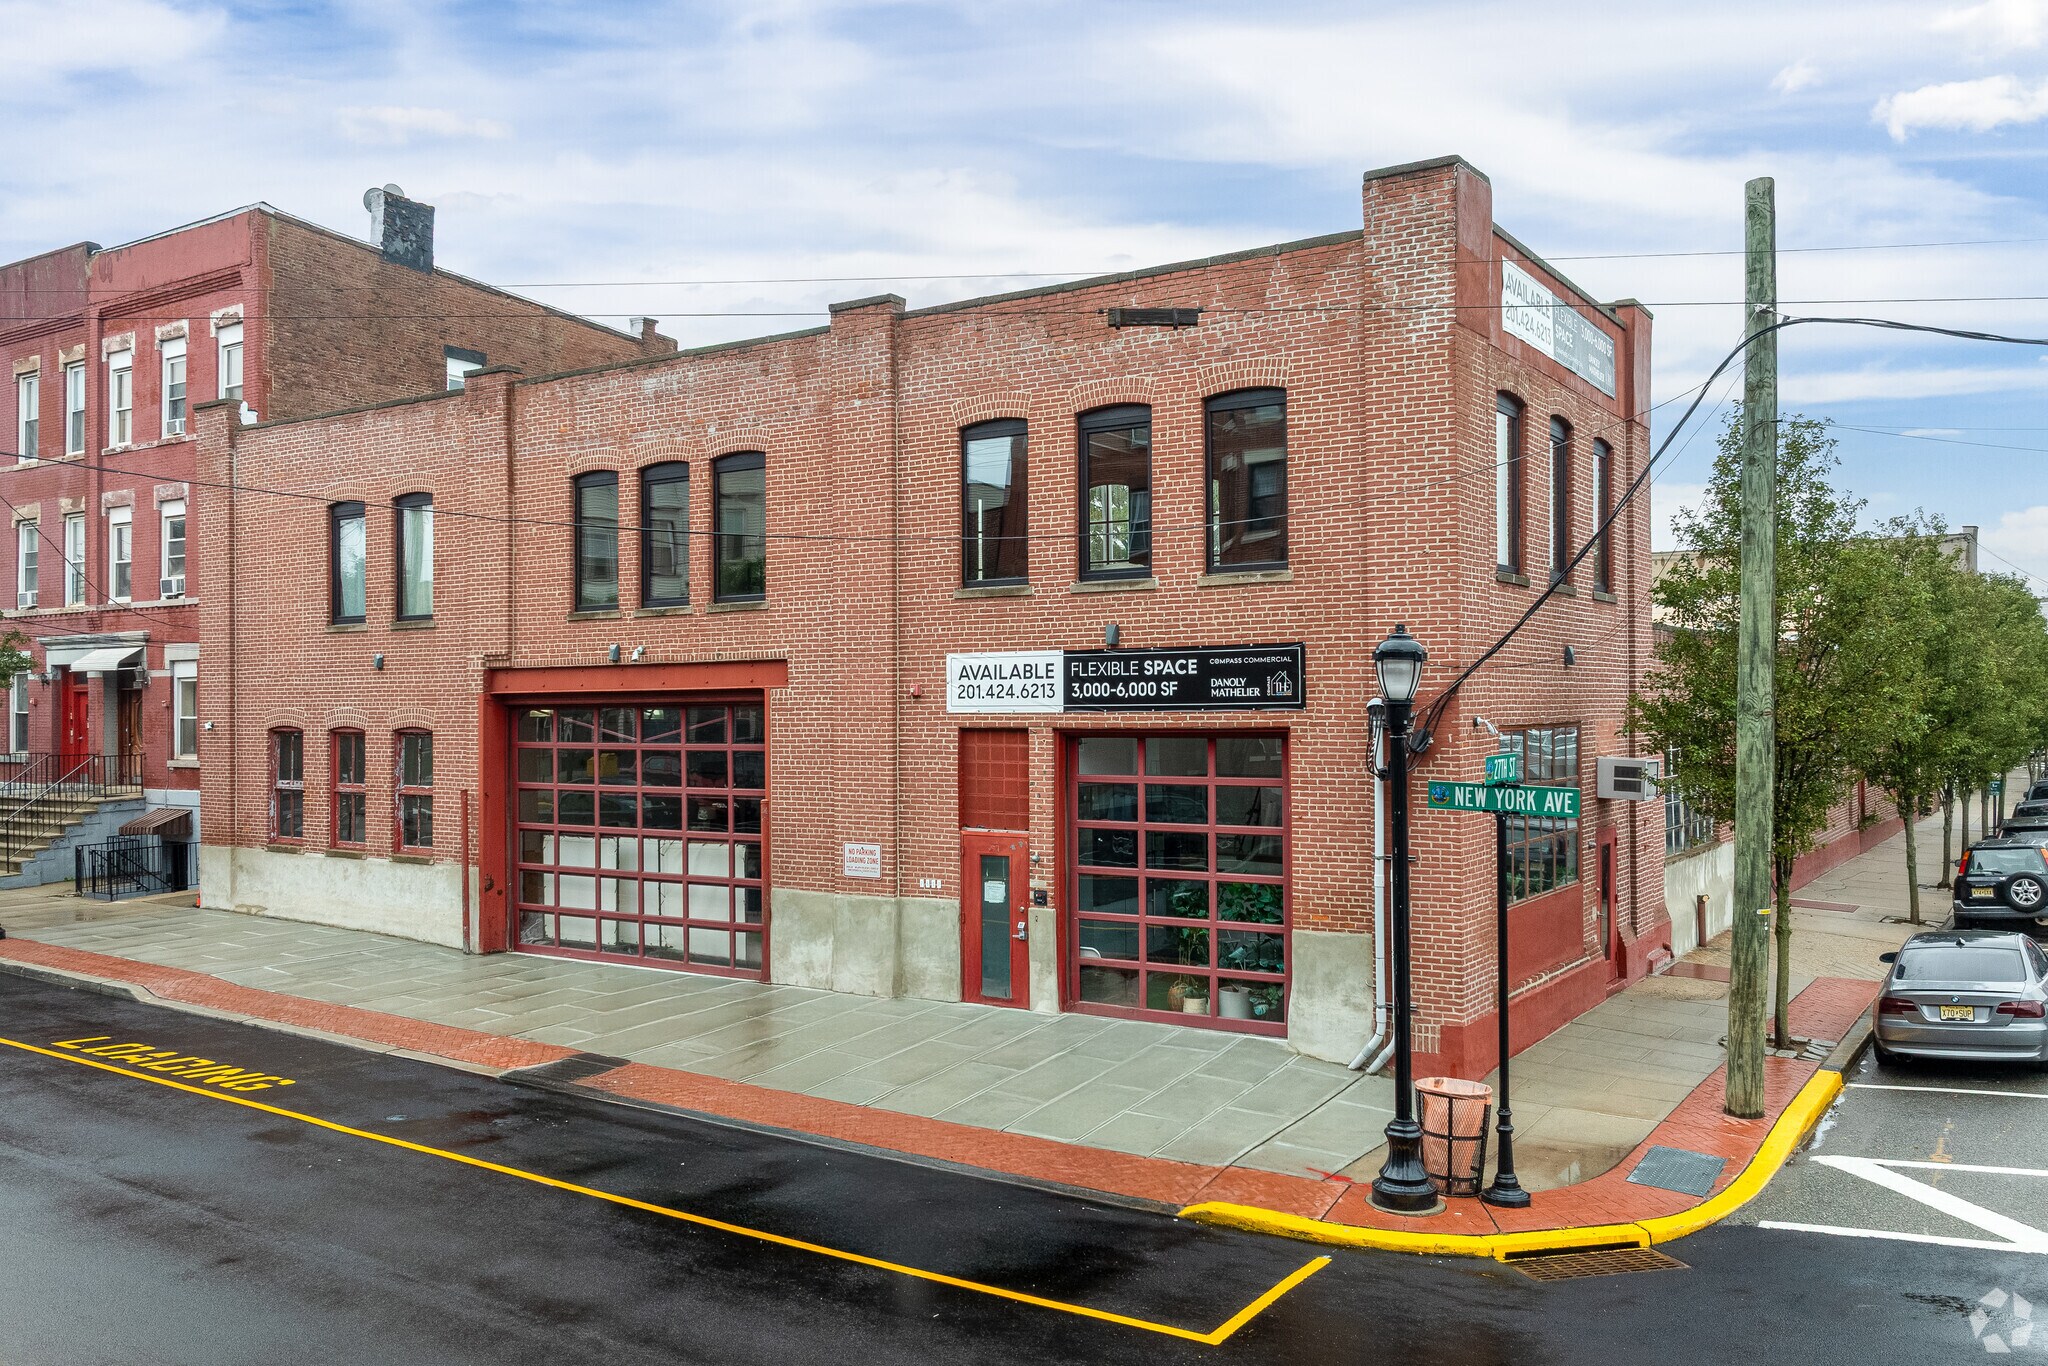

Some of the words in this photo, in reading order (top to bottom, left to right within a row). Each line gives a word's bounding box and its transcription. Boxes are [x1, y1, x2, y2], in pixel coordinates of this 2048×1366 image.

[1505, 272, 1551, 319] AVAILABLE
[1505, 300, 1551, 346] 201.424.6213
[1555, 323, 1574, 348] SPACE
[1071, 660, 1139, 677] FLEXIBLE
[1143, 658, 1198, 676] SPACE
[1209, 657, 1243, 665] COMPASS
[1243, 656, 1292, 664] COMMERCIAL
[958, 663, 1055, 681] AVAILABLE
[957, 683, 1056, 699] 201.424.6213
[1071, 681, 1157, 699] 3,000-6,000
[1160, 681, 1178, 696] SF
[1210, 677, 1247, 687] DANOLY
[1211, 687, 1261, 697] MATHELIER
[1493, 758, 1508, 780] 27TH
[1508, 757, 1517, 778] ST
[1454, 786, 1487, 808] NEW
[1494, 788, 1537, 812] YORK
[1543, 791, 1574, 814] AVE
[846, 856, 866, 864] LOADING
[867, 857, 879, 865] ZONE
[856, 848, 876, 857] PARKING
[50, 1035, 297, 1092] LOADING
